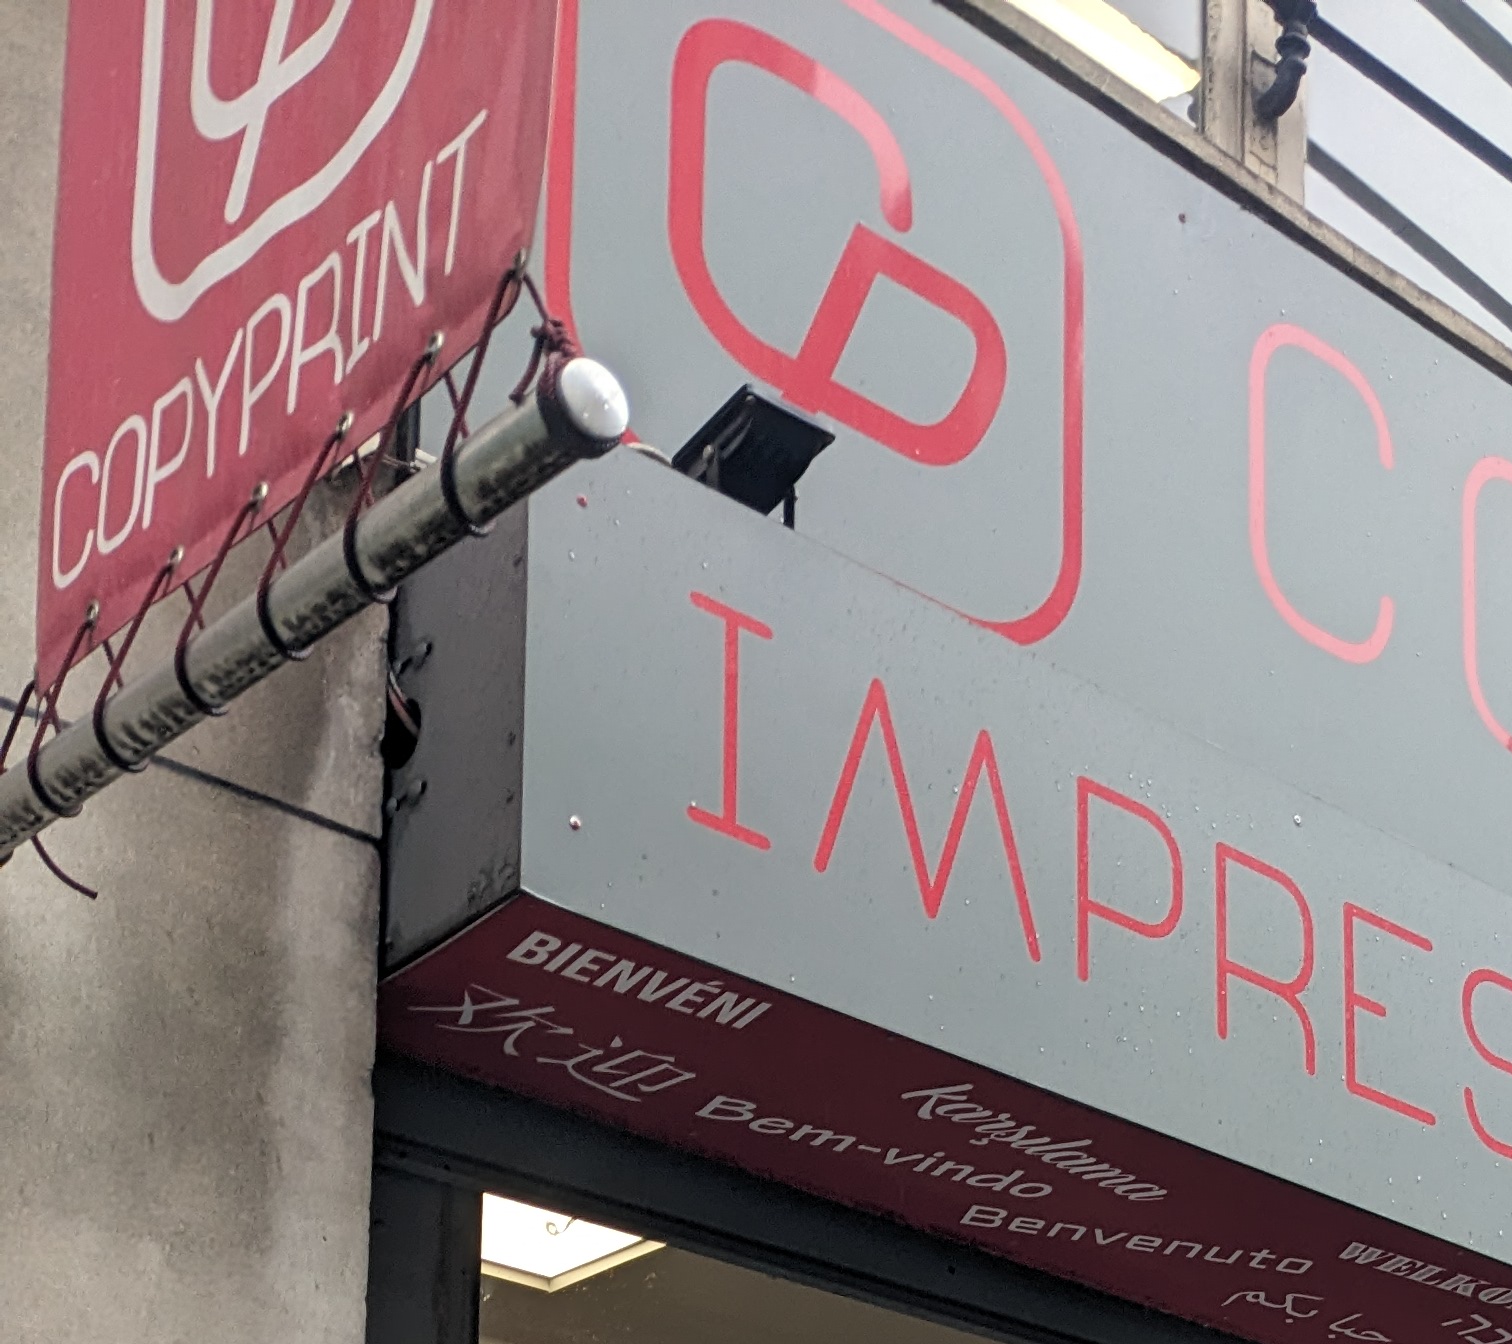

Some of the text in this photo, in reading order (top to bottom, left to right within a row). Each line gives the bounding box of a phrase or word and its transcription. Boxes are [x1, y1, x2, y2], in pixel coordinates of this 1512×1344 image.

[51, 109, 488, 589] COPYPRINT
[505, 930, 773, 1030] BIENVÉNI
[407, 983, 697, 1102] 欢迎
[695, 1095, 1053, 1198] Bem-vindo
[959, 1204, 1314, 1275] Benvenuto
[1220, 1290, 1326, 1323] بكم
